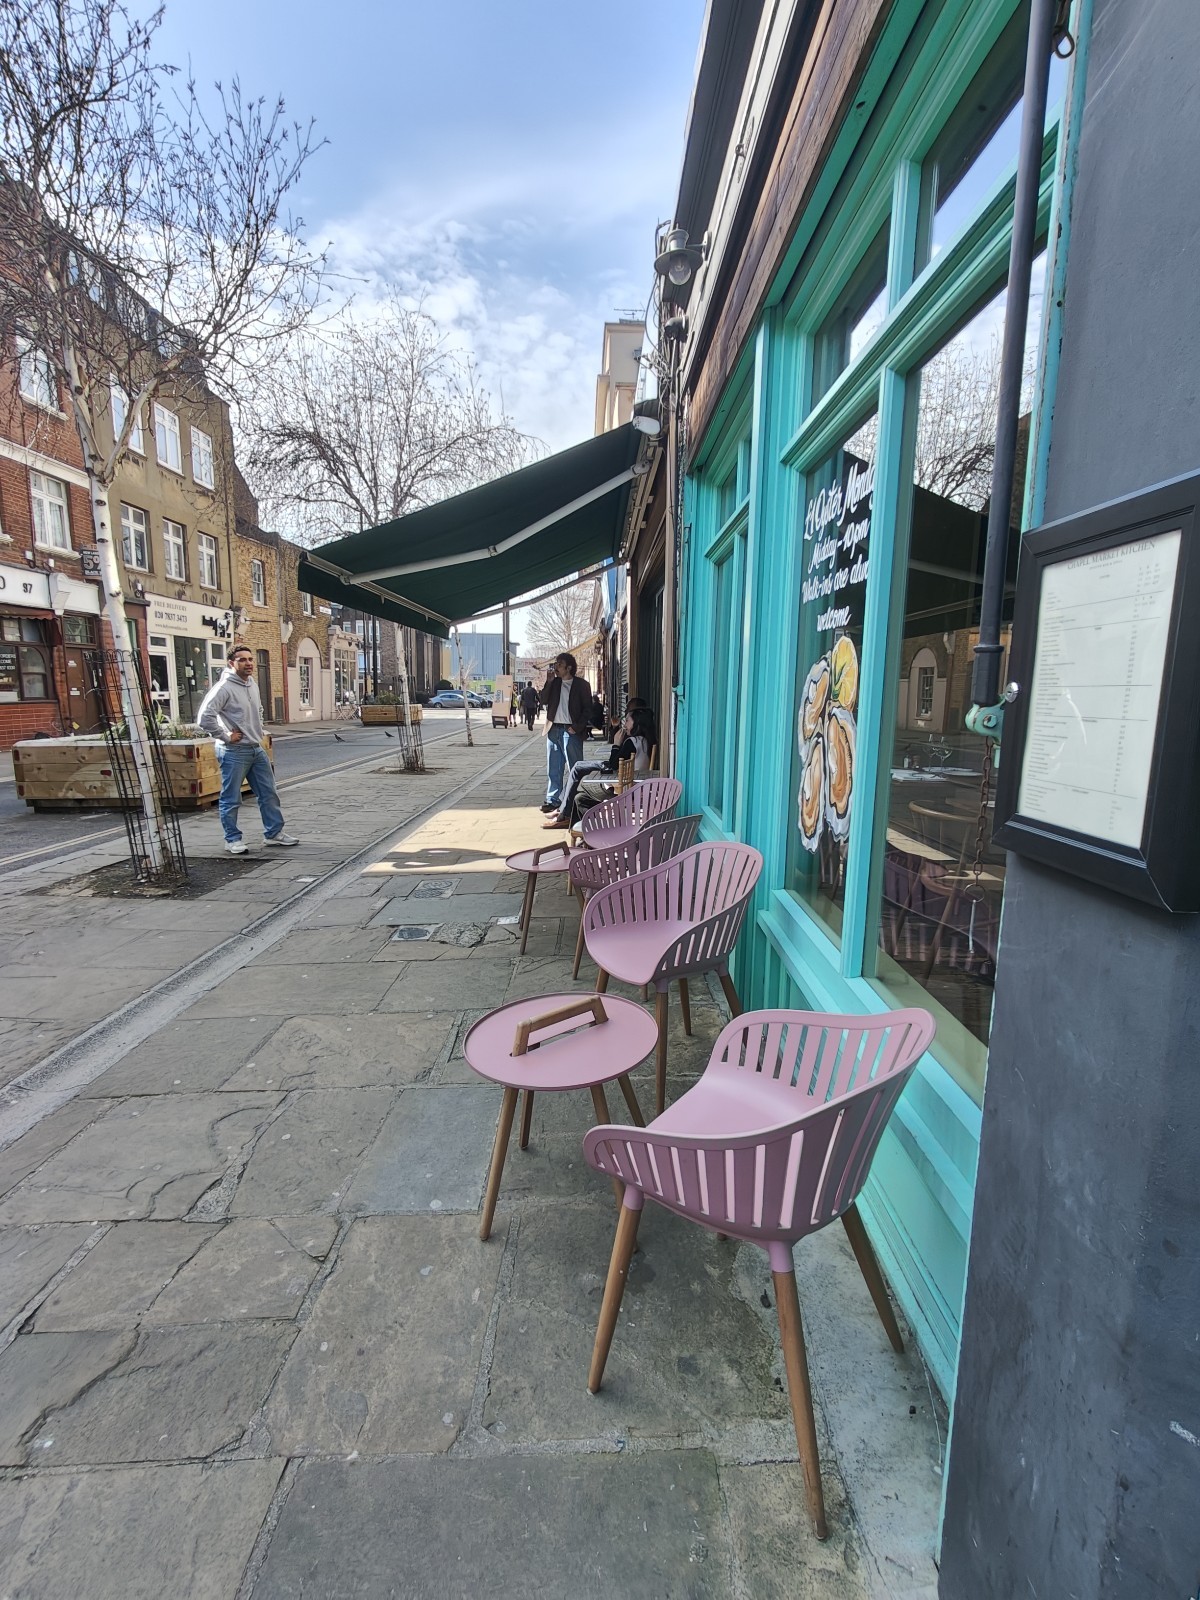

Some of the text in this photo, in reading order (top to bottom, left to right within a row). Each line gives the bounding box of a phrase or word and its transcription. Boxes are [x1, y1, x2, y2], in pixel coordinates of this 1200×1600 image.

[22, 582, 33, 594] 97
[833, 567, 849, 592] are
[816, 605, 852, 632] welcome
